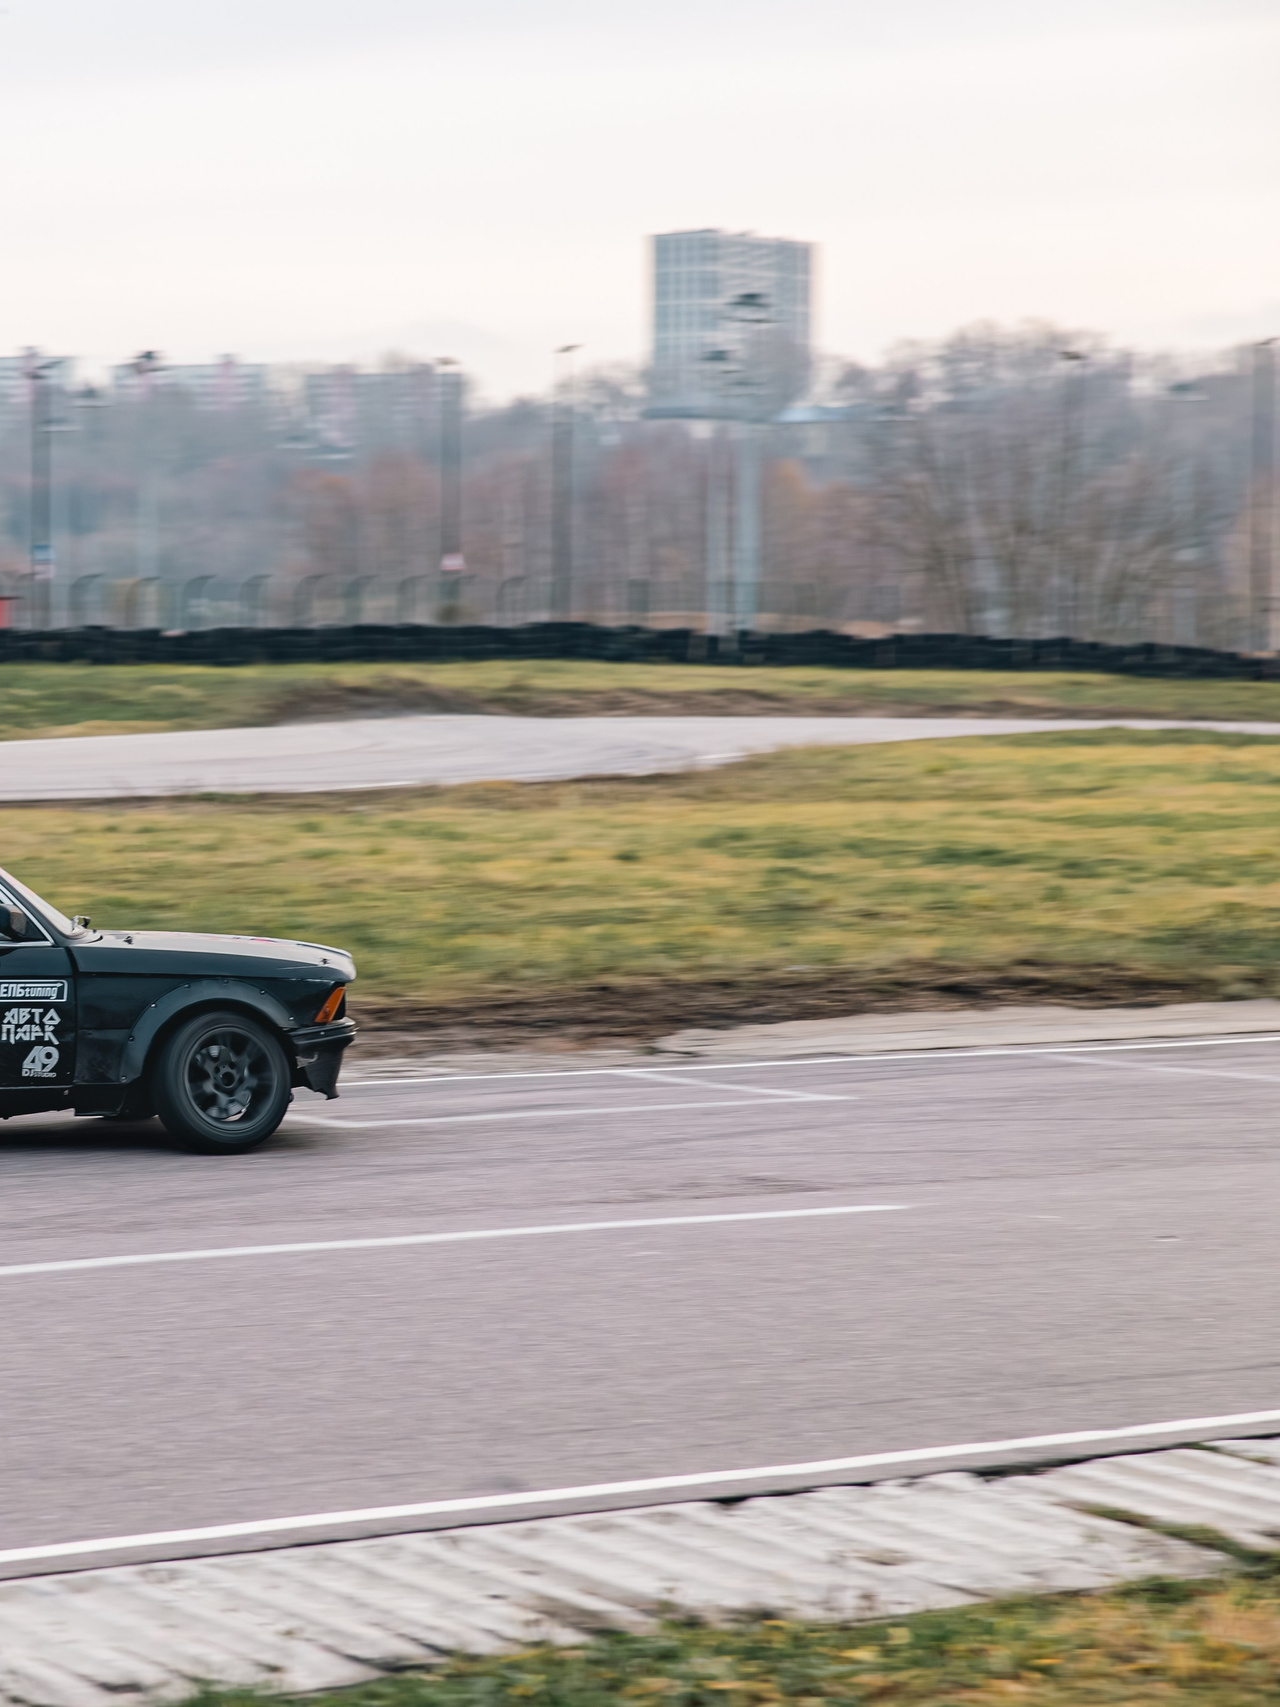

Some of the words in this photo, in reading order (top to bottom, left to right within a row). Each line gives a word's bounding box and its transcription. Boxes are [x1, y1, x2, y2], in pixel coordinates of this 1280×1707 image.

[2, 1008, 61, 1025] АВТО
[1, 1024, 60, 1045] ПАРК
[22, 1045, 59, 1072] 49
